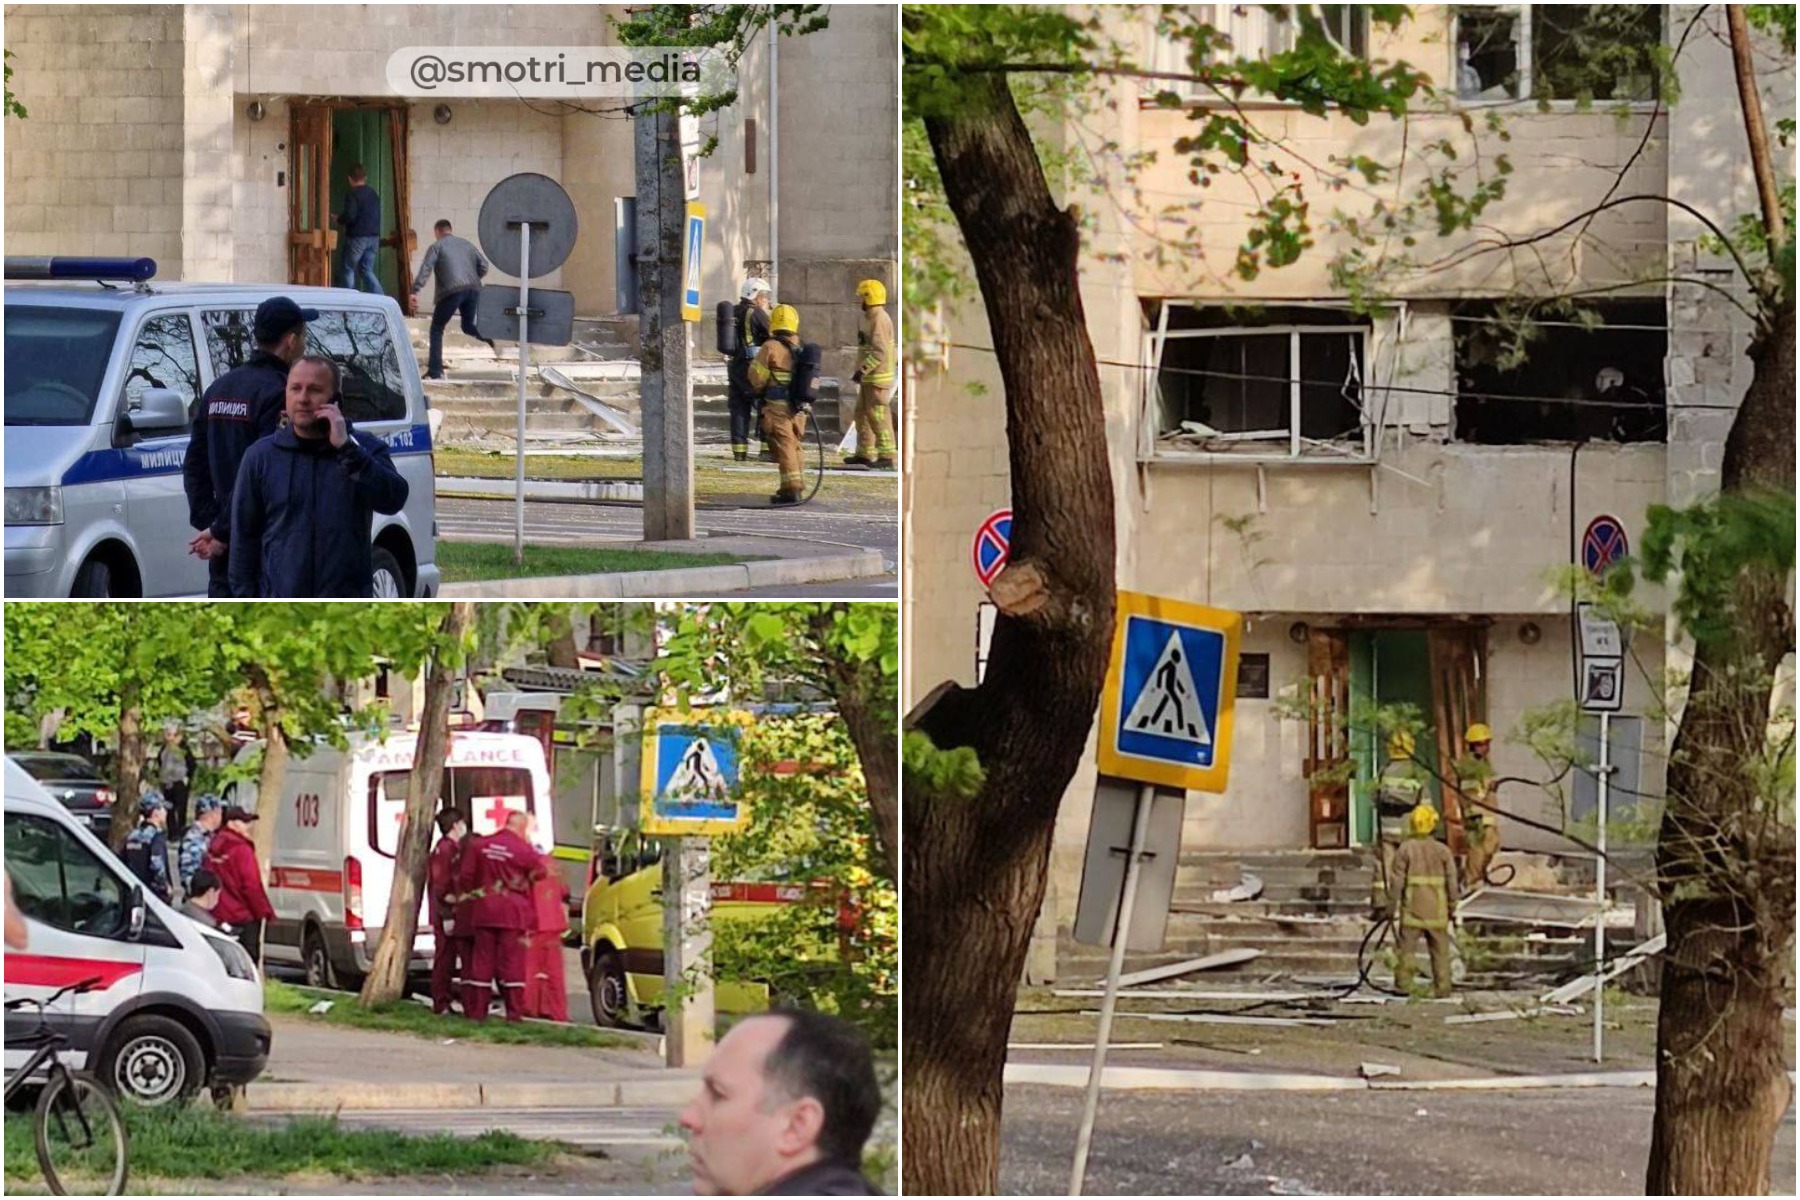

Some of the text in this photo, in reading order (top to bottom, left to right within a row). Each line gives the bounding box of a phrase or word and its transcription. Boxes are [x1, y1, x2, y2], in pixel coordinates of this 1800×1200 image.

[209, 401, 247, 417] МИЛИЦИЯ
[400, 432, 414, 447] 102
[141, 450, 186, 469] МИЛИЦИ
[377, 749, 525, 765] AMLANCE
[295, 793, 319, 828] 103
